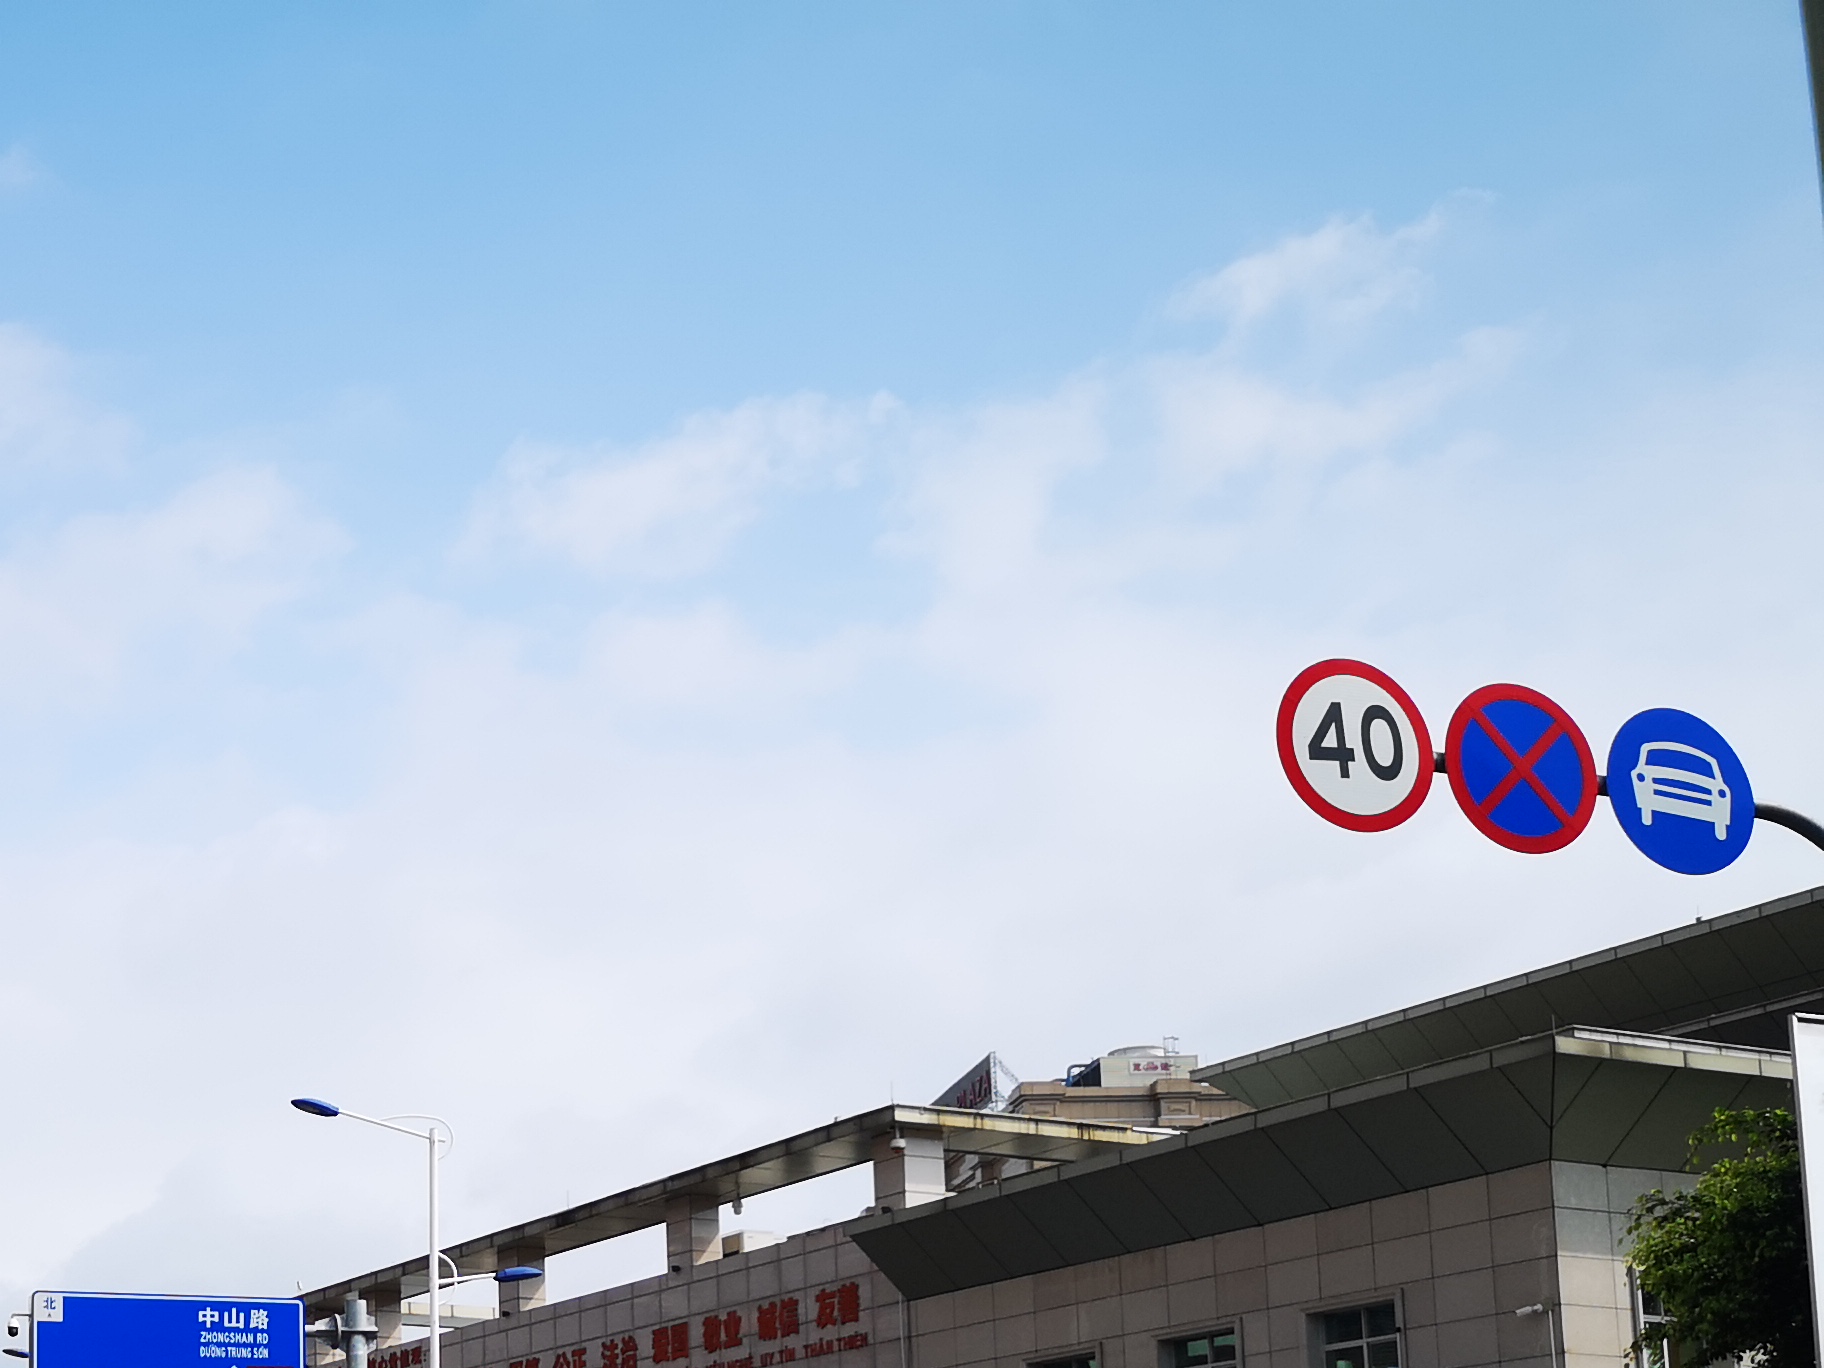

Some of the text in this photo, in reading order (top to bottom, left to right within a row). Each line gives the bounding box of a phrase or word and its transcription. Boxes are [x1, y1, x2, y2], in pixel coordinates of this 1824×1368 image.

[1307, 701, 1404, 782] 40
[42, 1296, 57, 1311] 北
[198, 1306, 269, 1330] 中山路
[652, 1322, 690, 1364] 爱国
[702, 1310, 743, 1354] 敬业
[757, 1297, 800, 1341] 诚信
[815, 1281, 861, 1330] 友善
[200, 1331, 269, 1345] ZHONGSHAN RD
[227, 1346, 252, 1359] TRUNG
